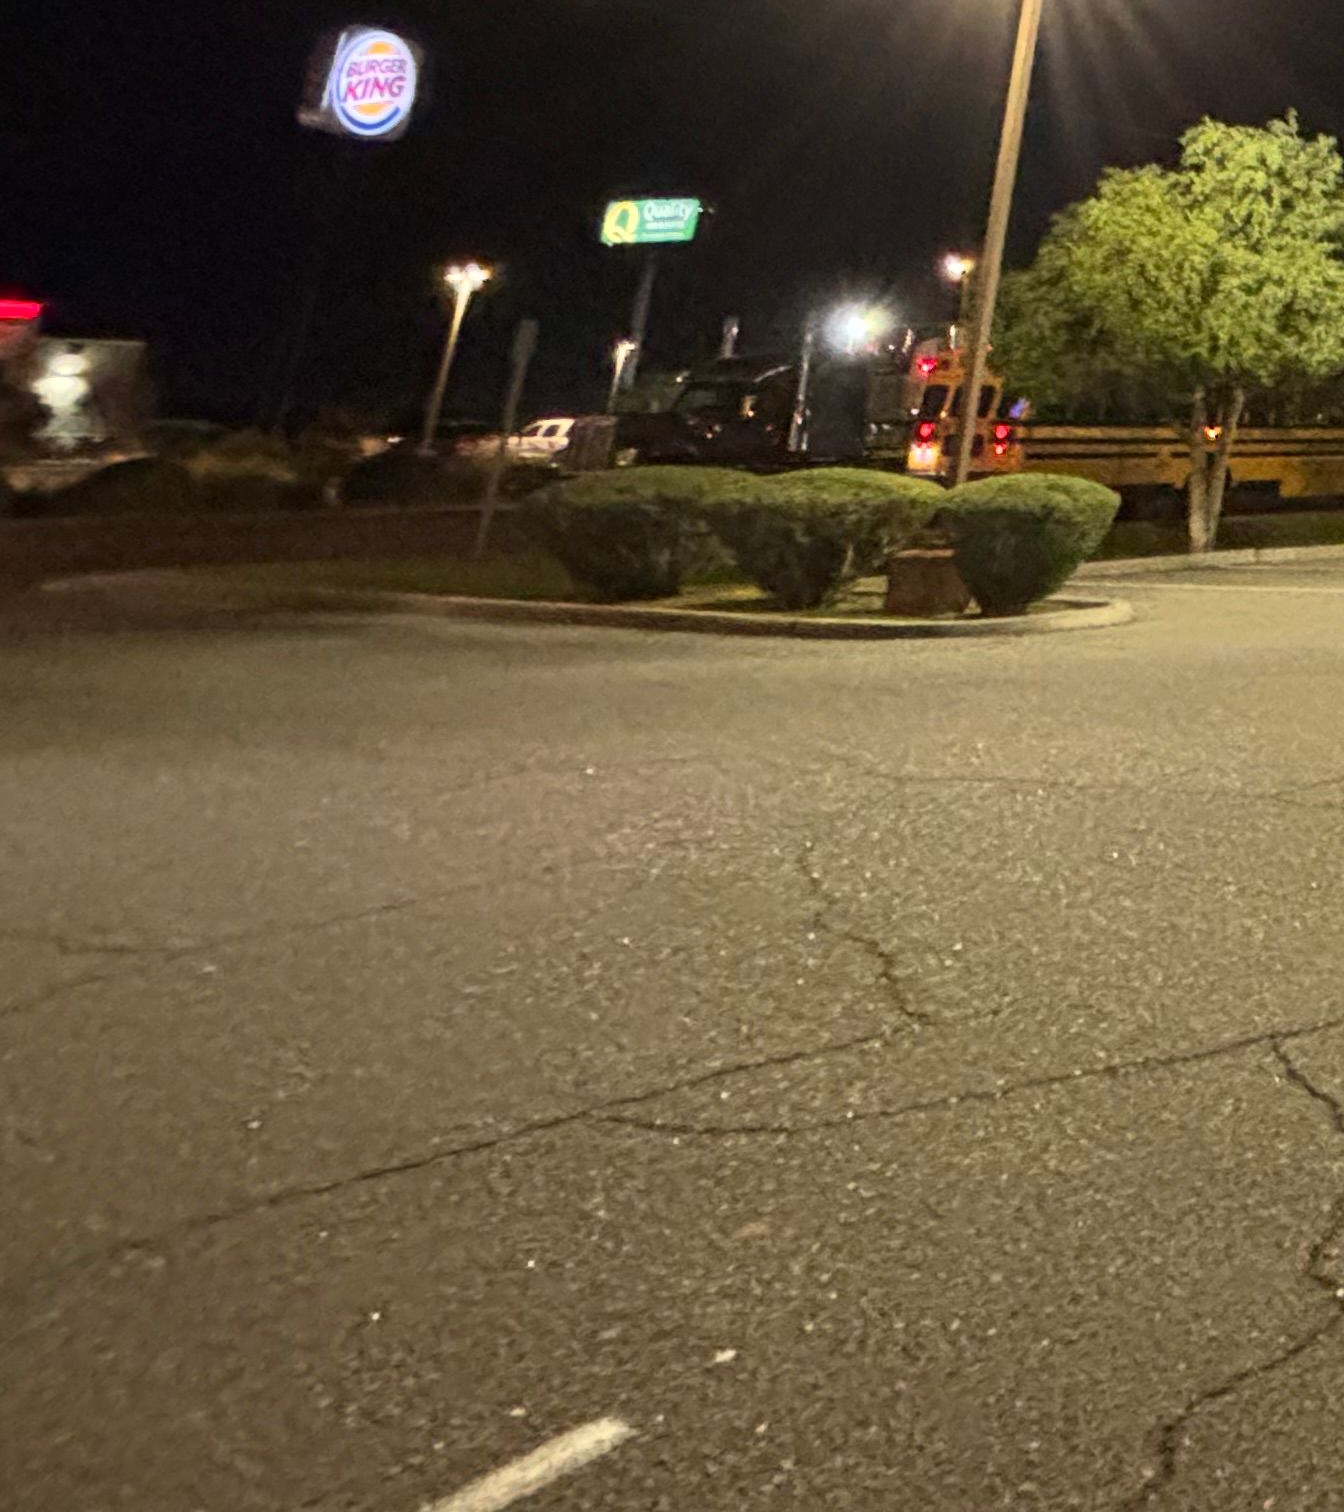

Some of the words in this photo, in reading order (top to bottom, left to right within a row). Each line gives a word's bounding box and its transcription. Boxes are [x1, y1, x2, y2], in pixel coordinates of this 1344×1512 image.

[346, 59, 406, 78] BURGER
[342, 76, 407, 103] KING
[643, 200, 694, 221] Quality
